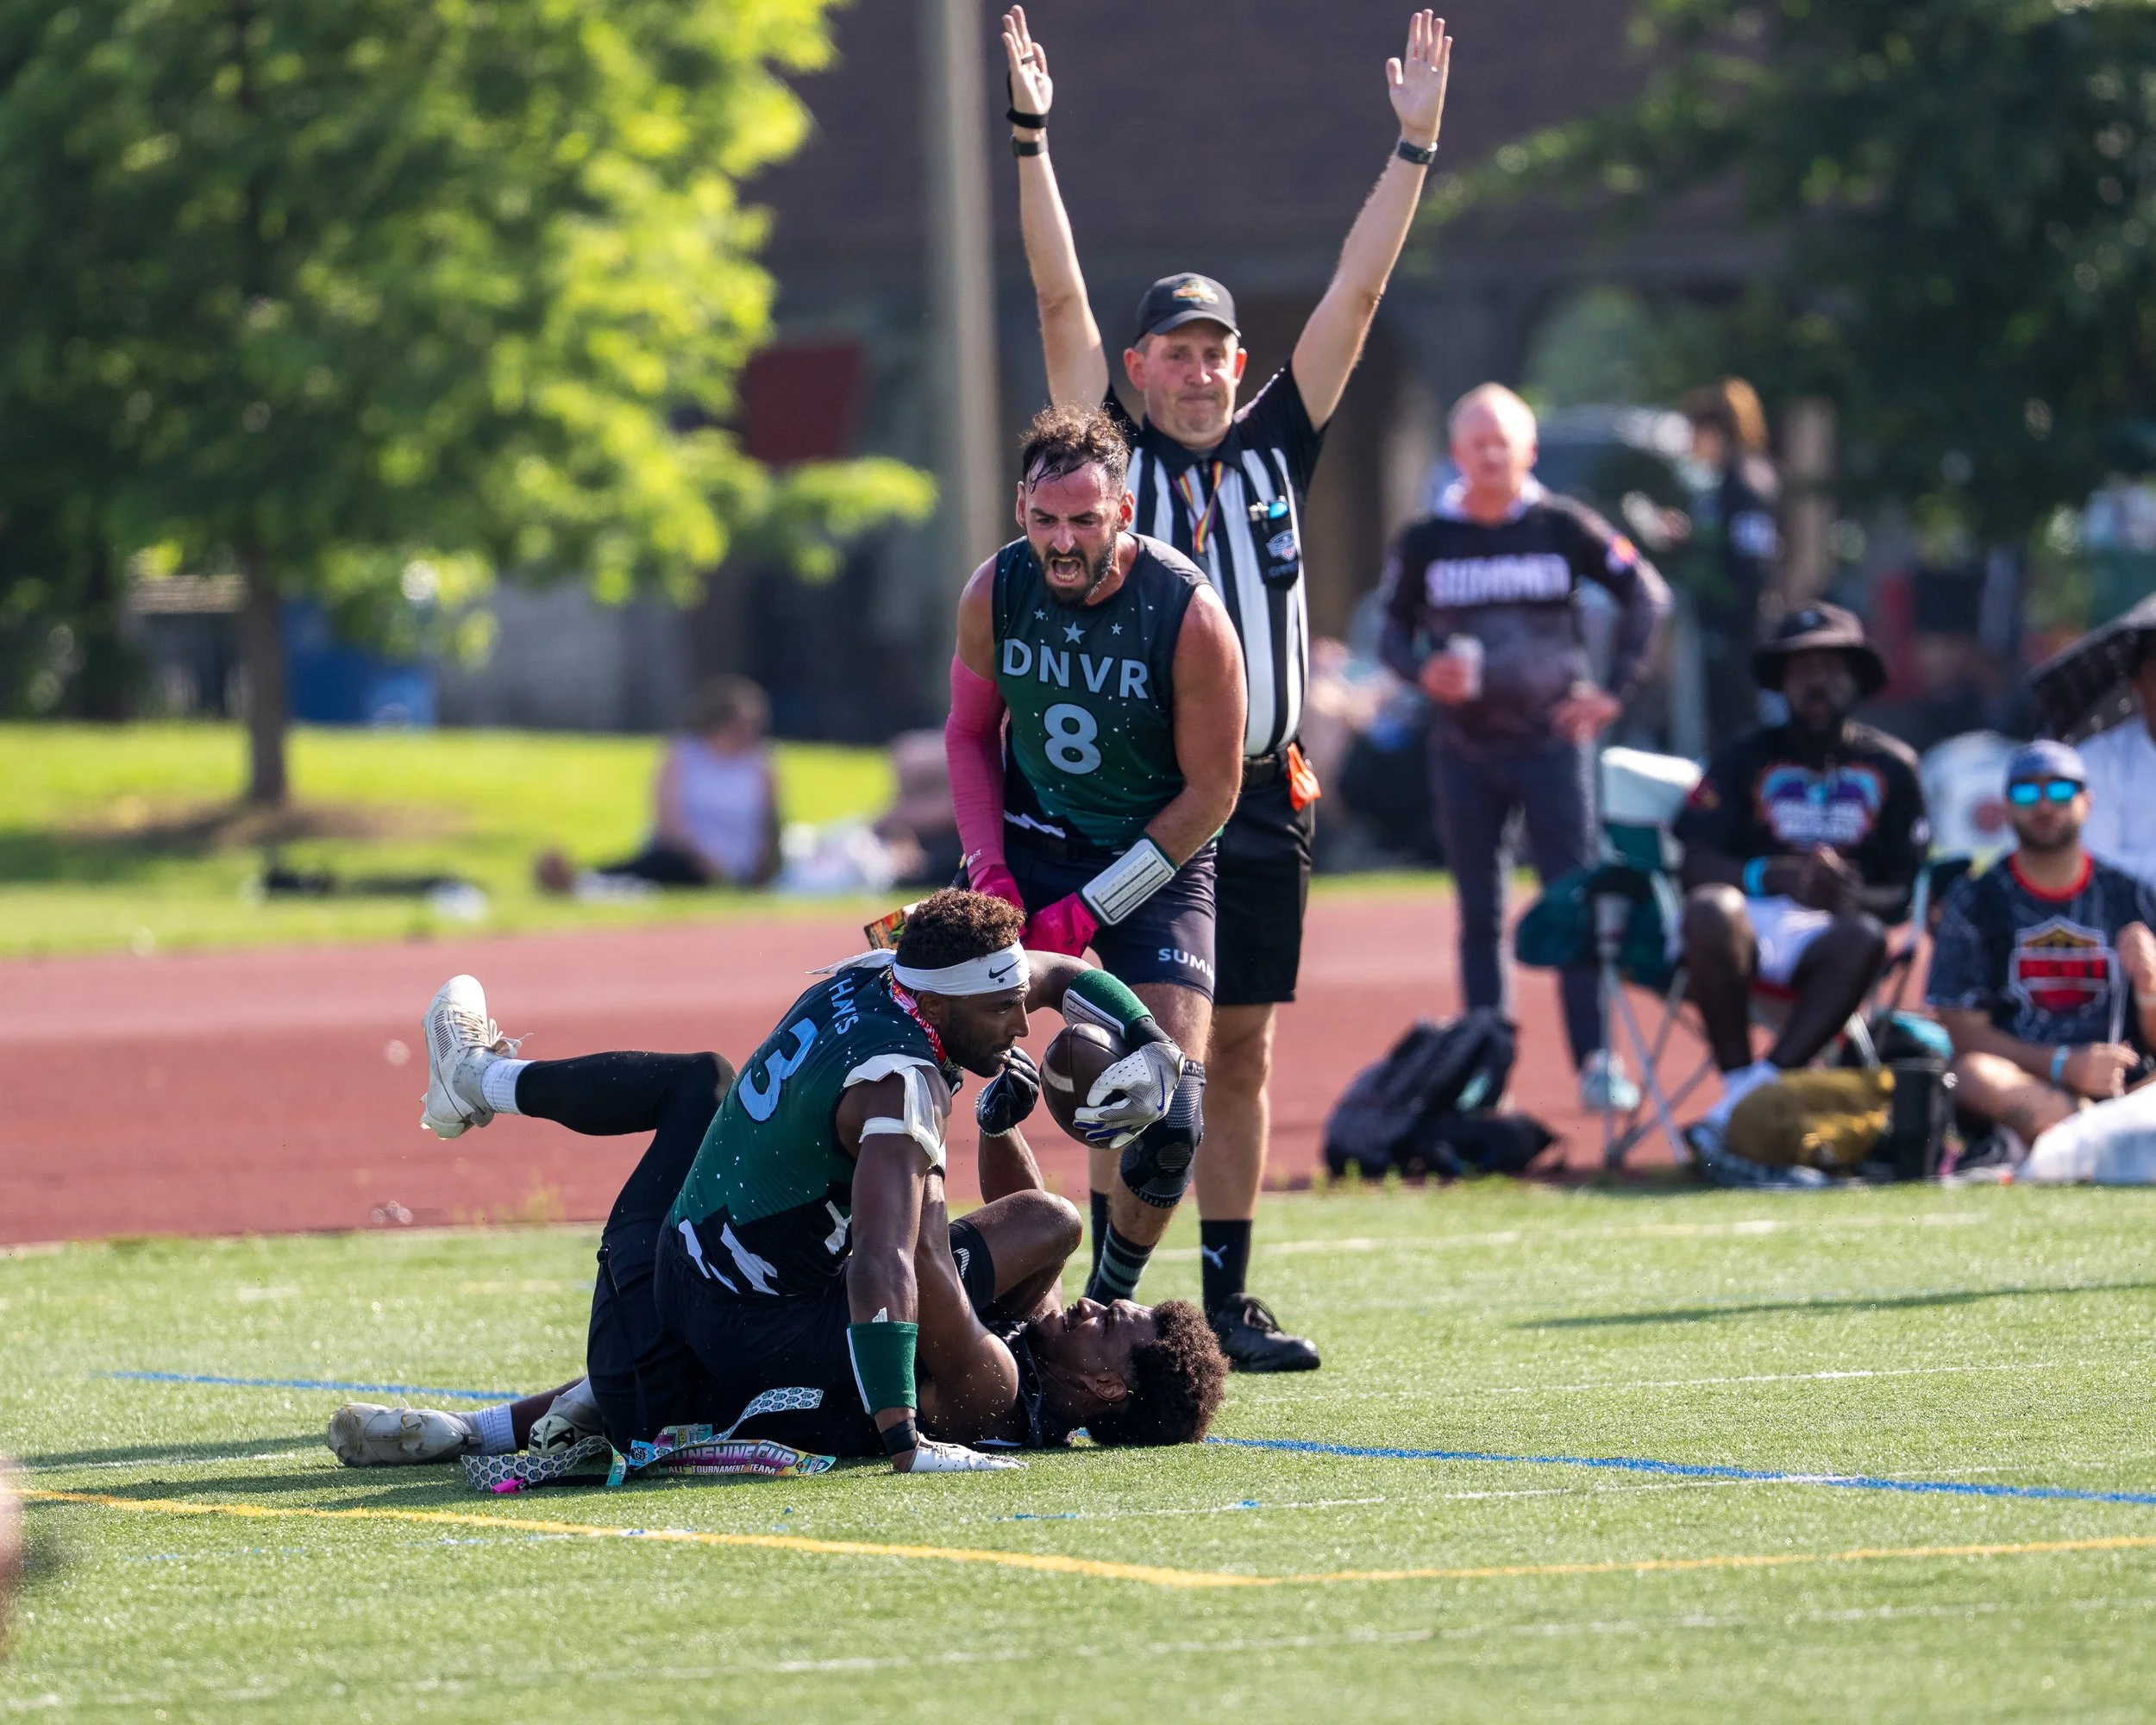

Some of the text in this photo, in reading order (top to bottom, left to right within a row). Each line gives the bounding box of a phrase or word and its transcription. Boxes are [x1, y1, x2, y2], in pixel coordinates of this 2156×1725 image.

[1002, 637, 1149, 699] DNVR
[1044, 703, 1102, 775] 8
[738, 1017, 818, 1121] 3
[691, 1465, 745, 1474] TOURNAMENT
[749, 1464, 776, 1475] TEAM
[756, 1445, 797, 1470] CUP
